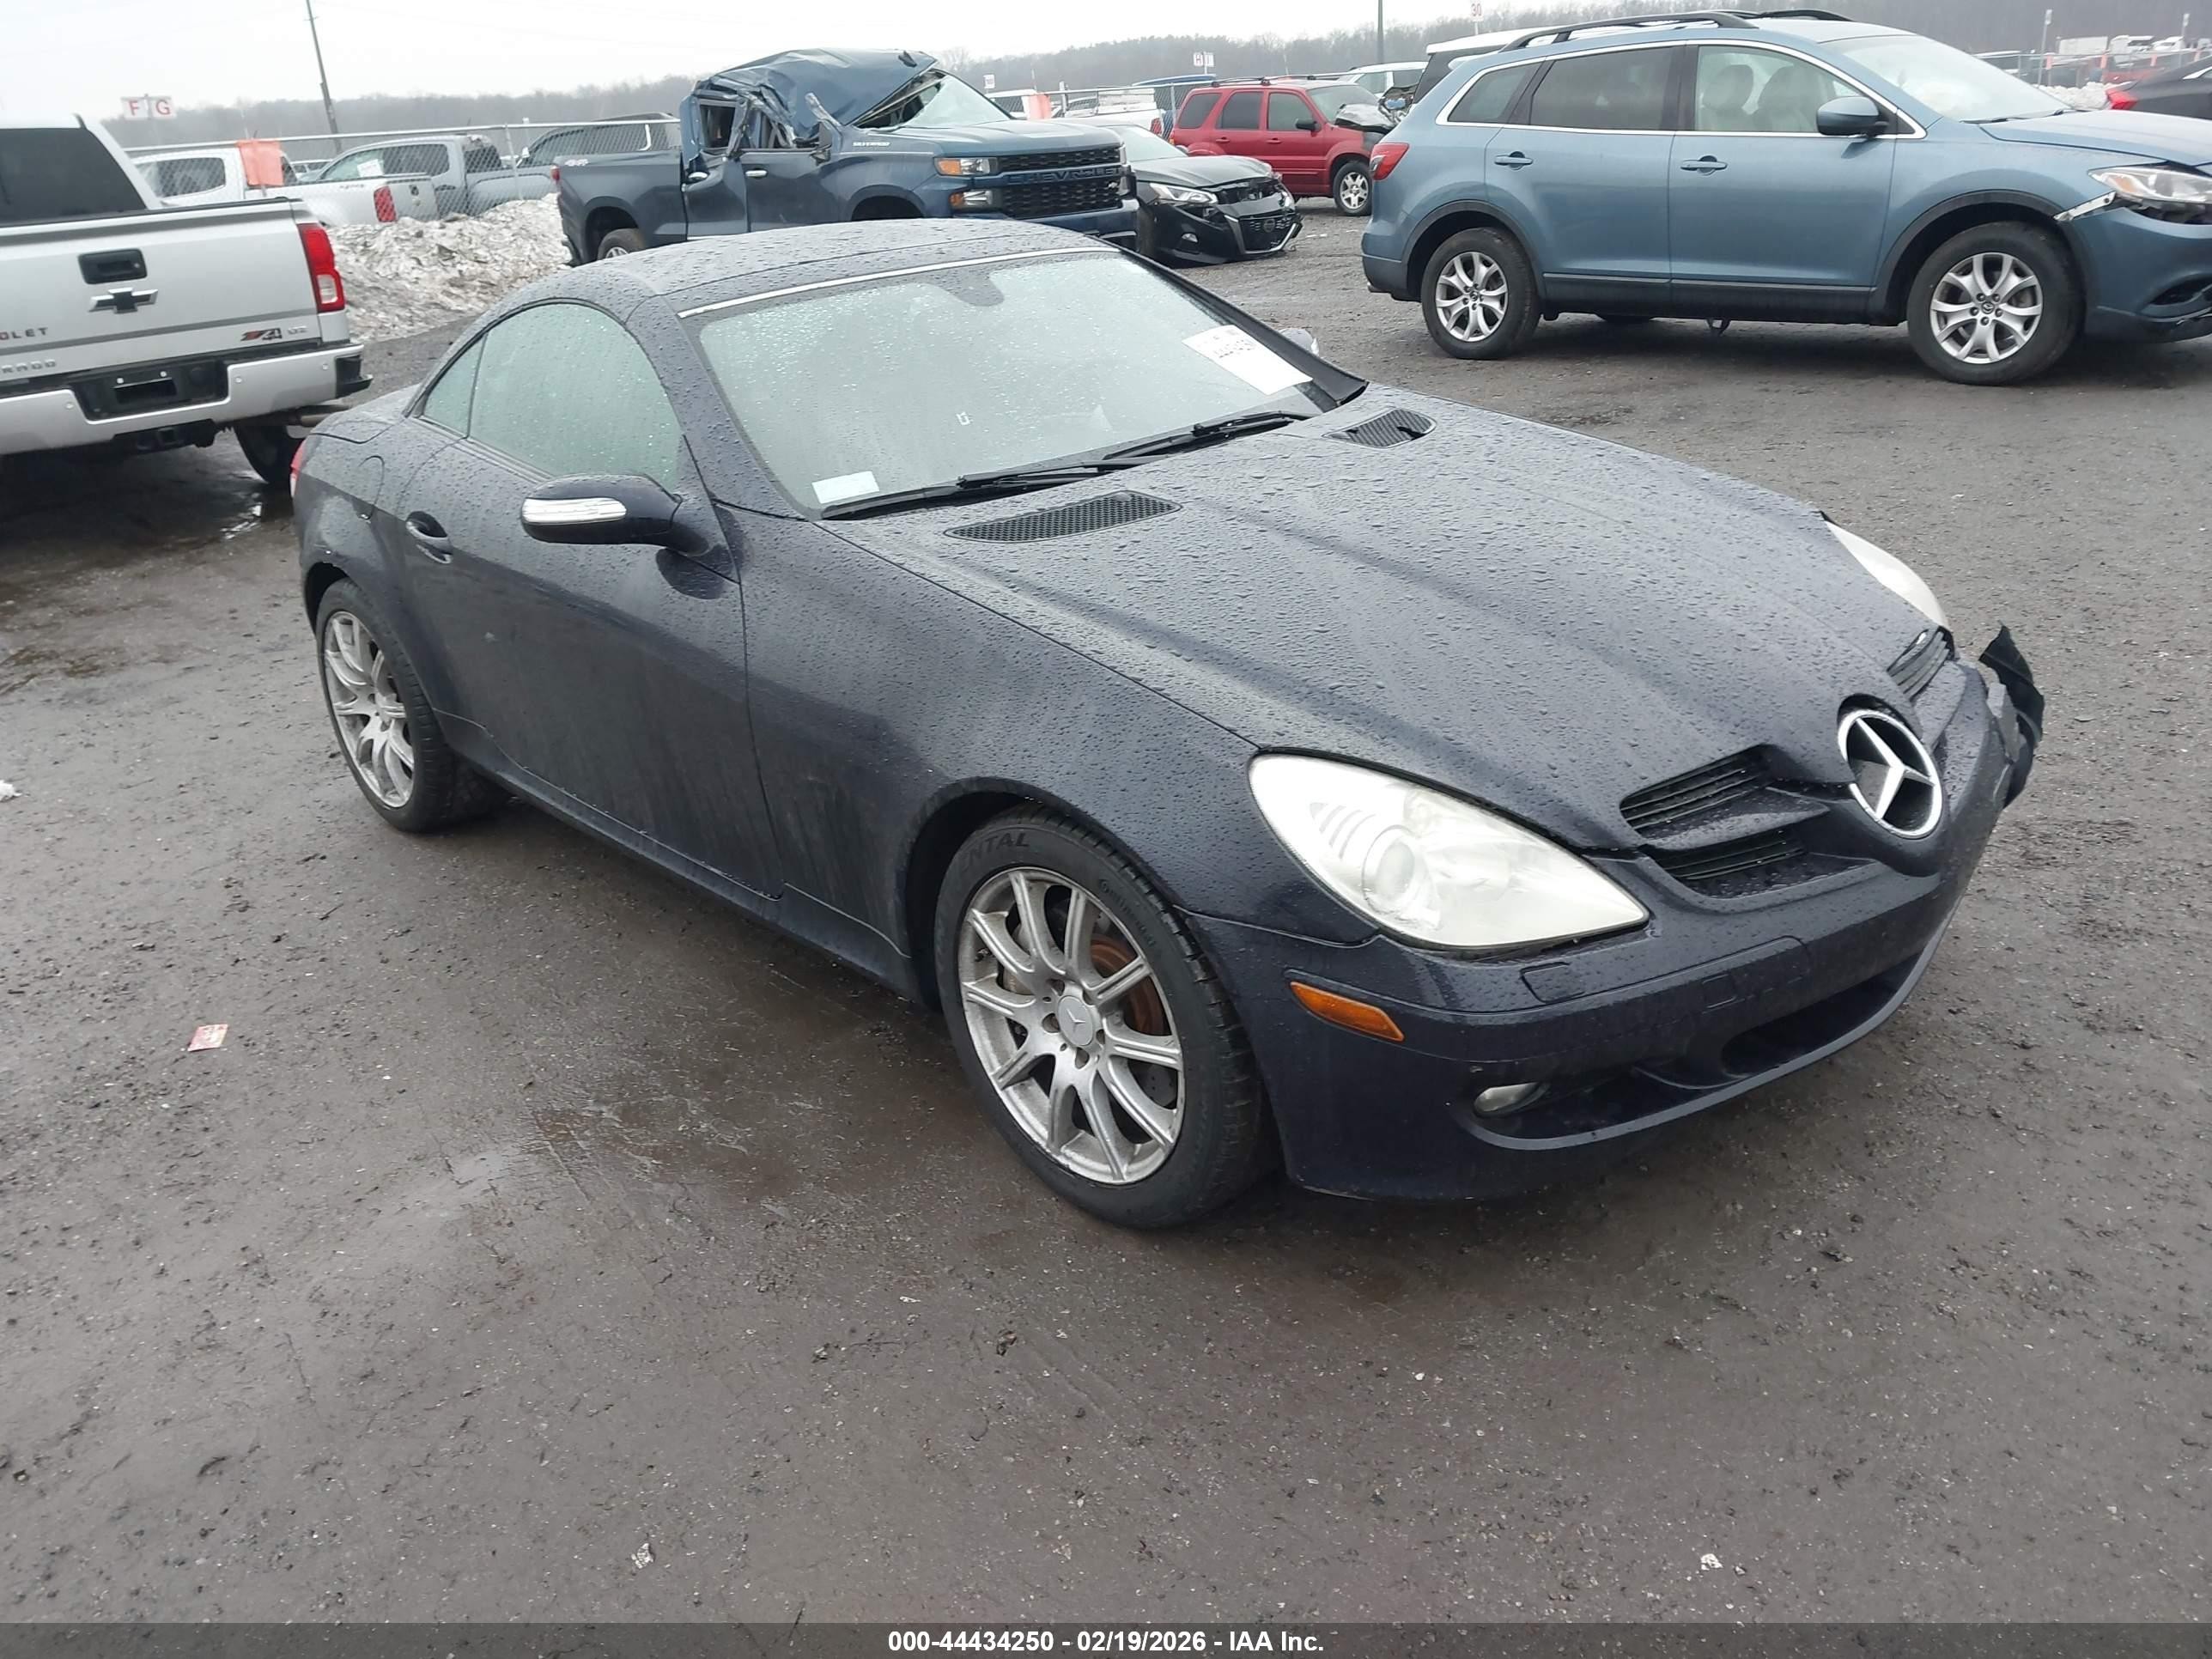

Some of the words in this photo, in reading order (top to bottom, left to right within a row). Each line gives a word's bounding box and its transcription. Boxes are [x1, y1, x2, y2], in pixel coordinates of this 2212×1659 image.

[1471, 3, 1481, 16] 30
[129, 100, 140, 116] F
[155, 99, 171, 115] G
